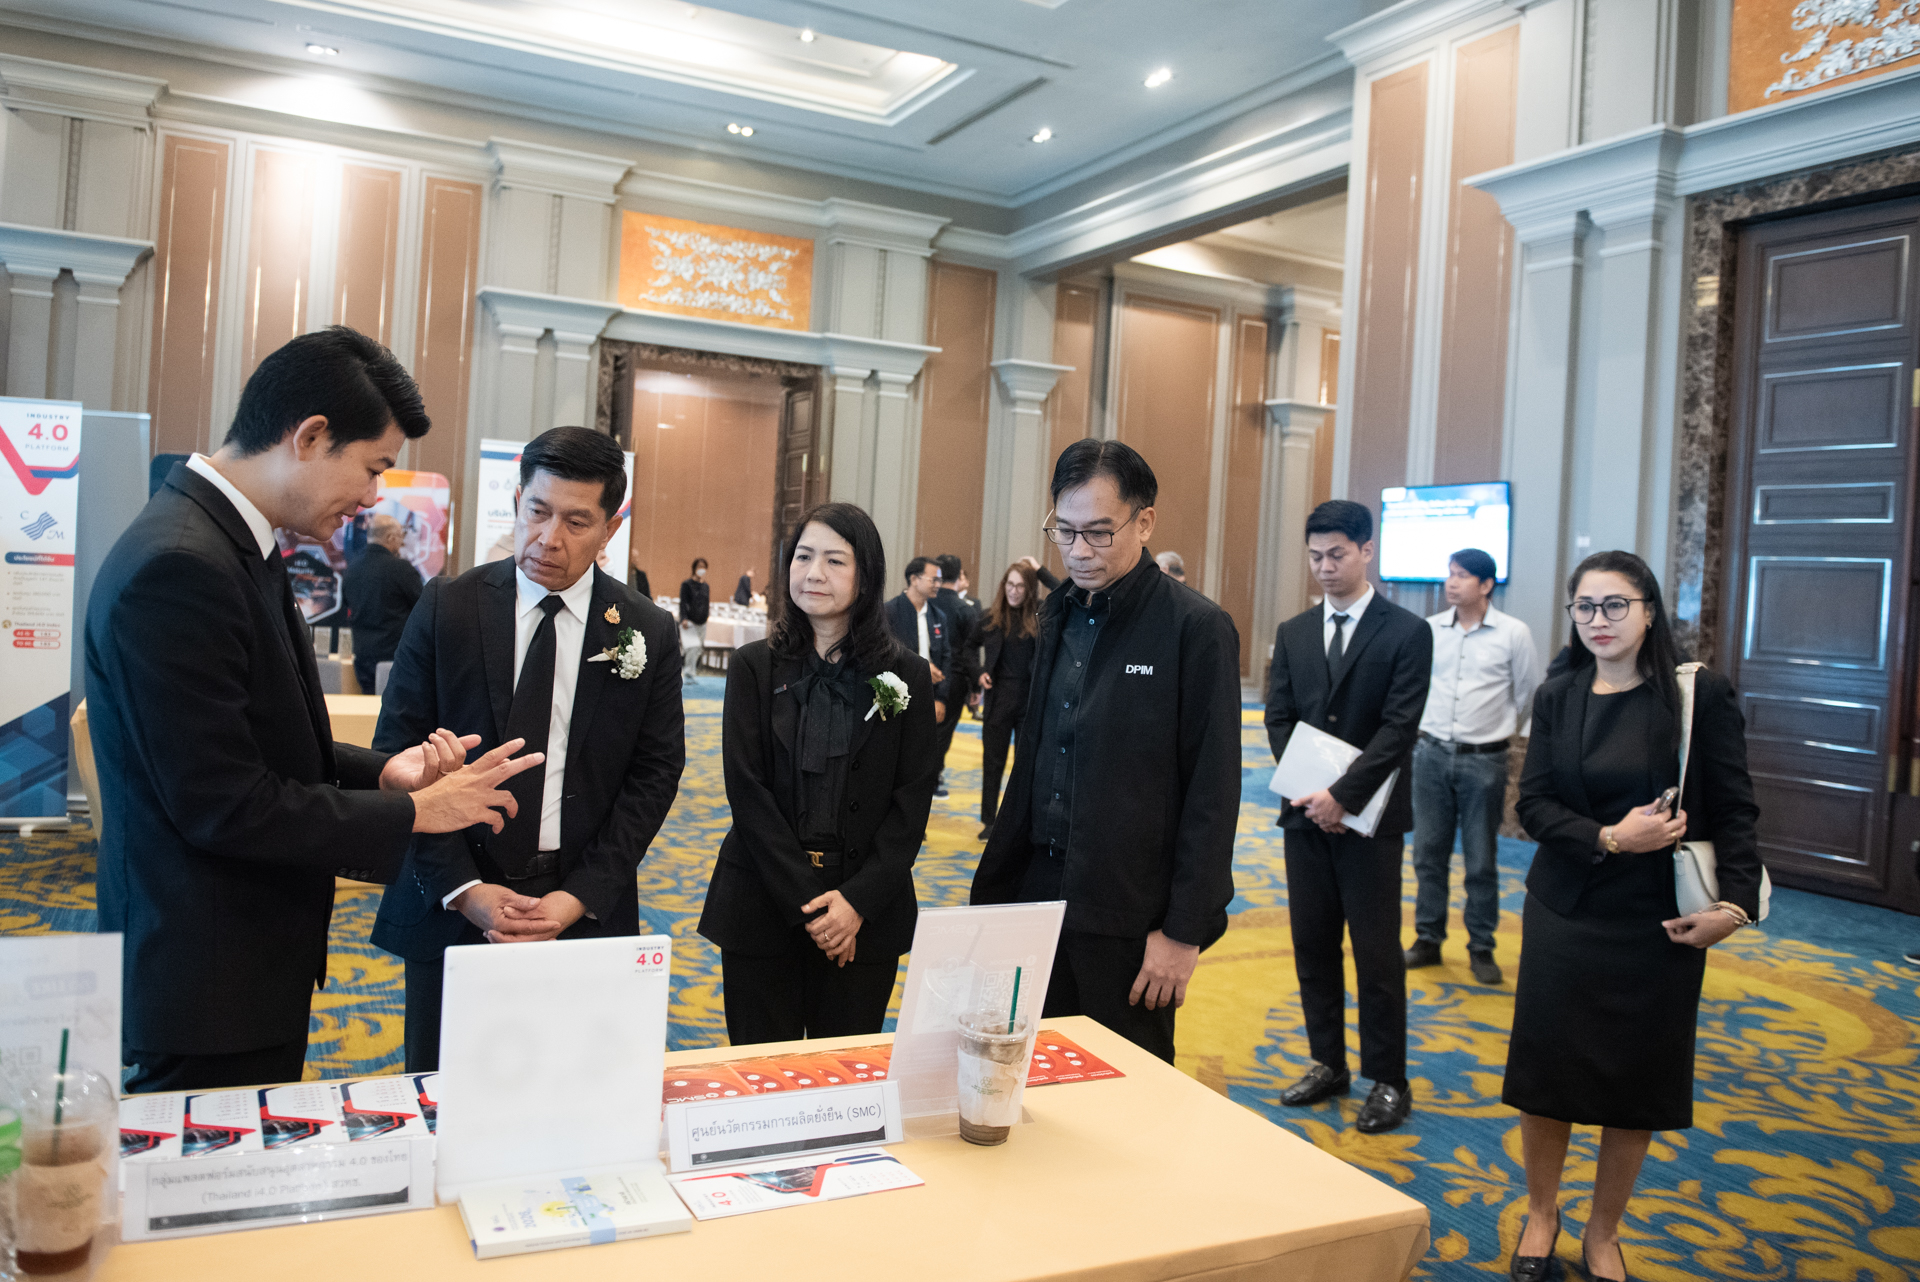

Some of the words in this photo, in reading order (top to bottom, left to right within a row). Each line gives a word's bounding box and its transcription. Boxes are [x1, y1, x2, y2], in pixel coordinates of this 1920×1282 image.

[26, 412, 70, 420] INDUSTRY
[28, 423, 68, 441] 4.0
[25, 443, 69, 452] PLATFORM
[20, 511, 29, 520] C
[1125, 664, 1154, 675] DPIM
[636, 952, 664, 966] 4.0
[691, 1105, 843, 1142] ศูนย์นวัตกรรมการผลิตยั่งยืน
[846, 1103, 882, 1122] (SMC)
[349, 1157, 367, 1167] 4.0
